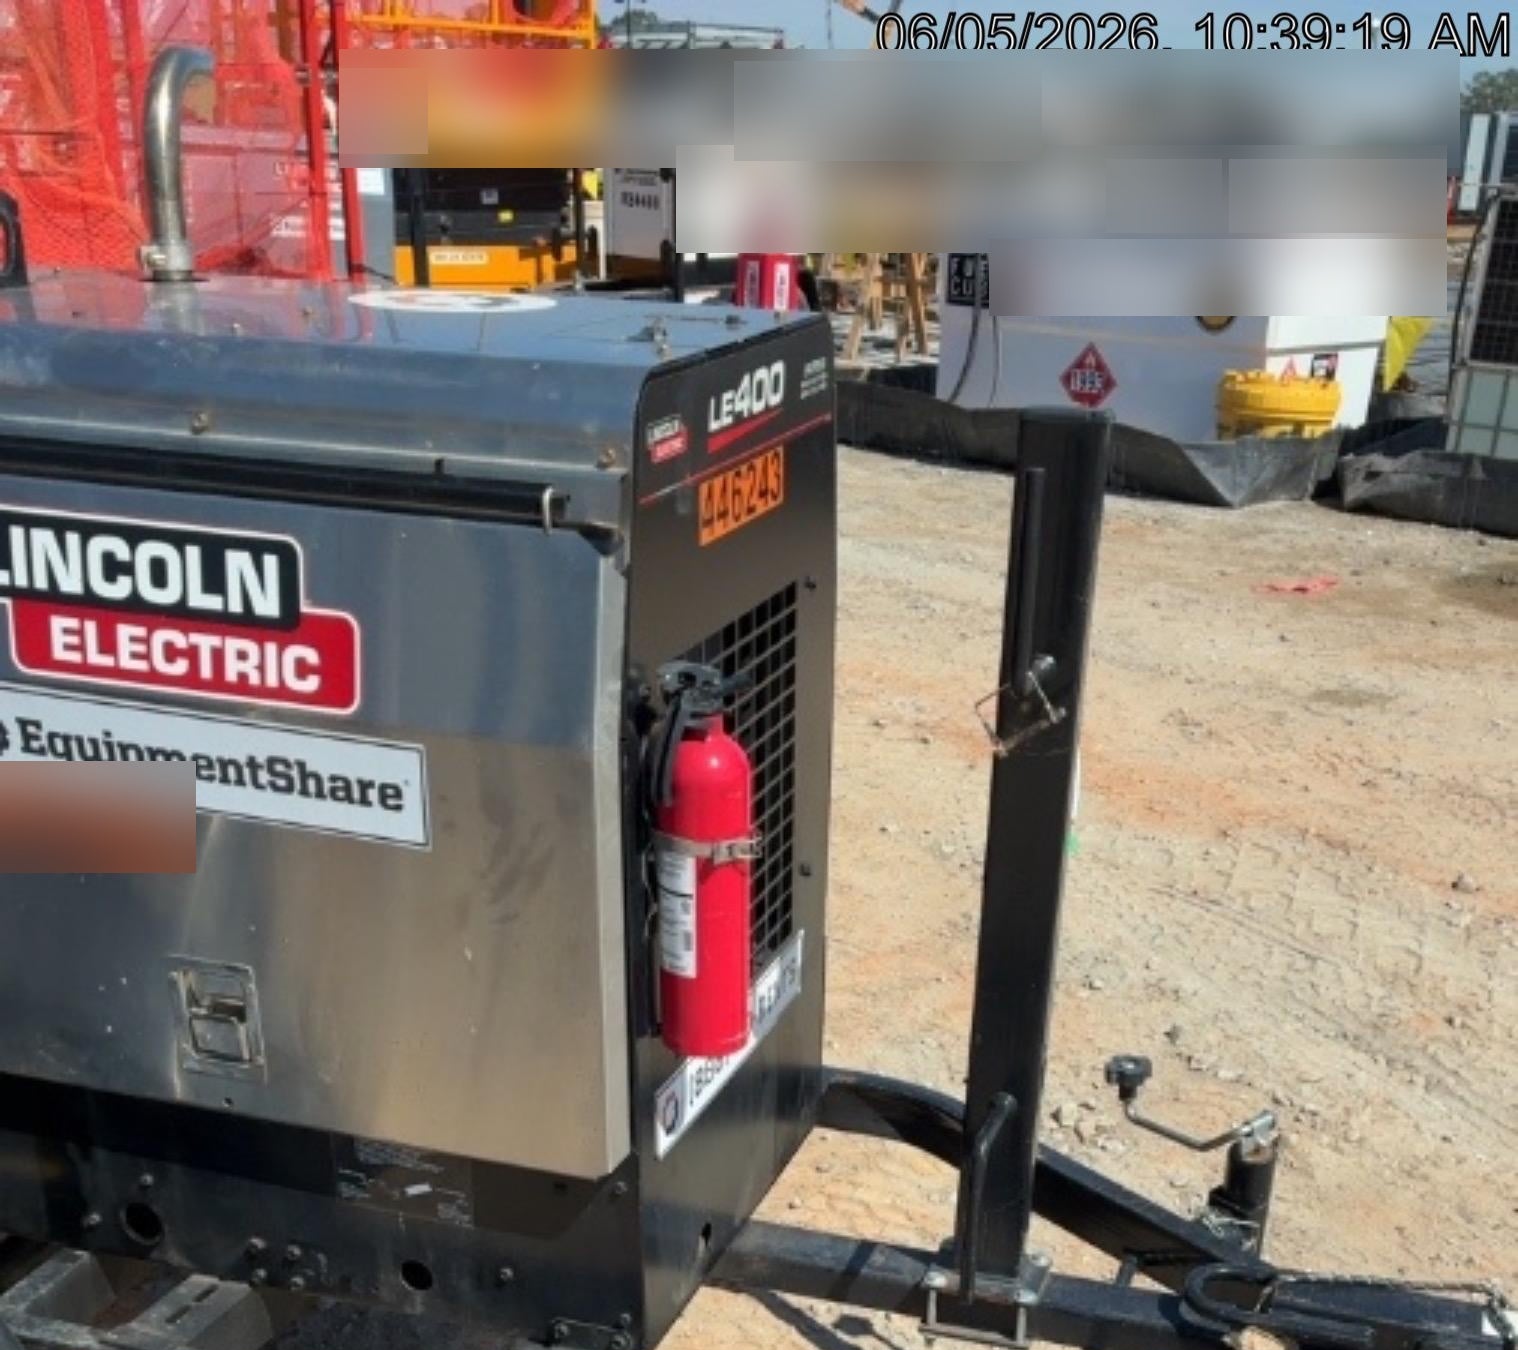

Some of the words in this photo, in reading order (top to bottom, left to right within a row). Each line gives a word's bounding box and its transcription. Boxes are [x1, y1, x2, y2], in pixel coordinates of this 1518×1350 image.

[708, 359, 785, 433] LE400
[701, 448, 780, 537] 446243
[49, 614, 321, 693] ELECTRIC
